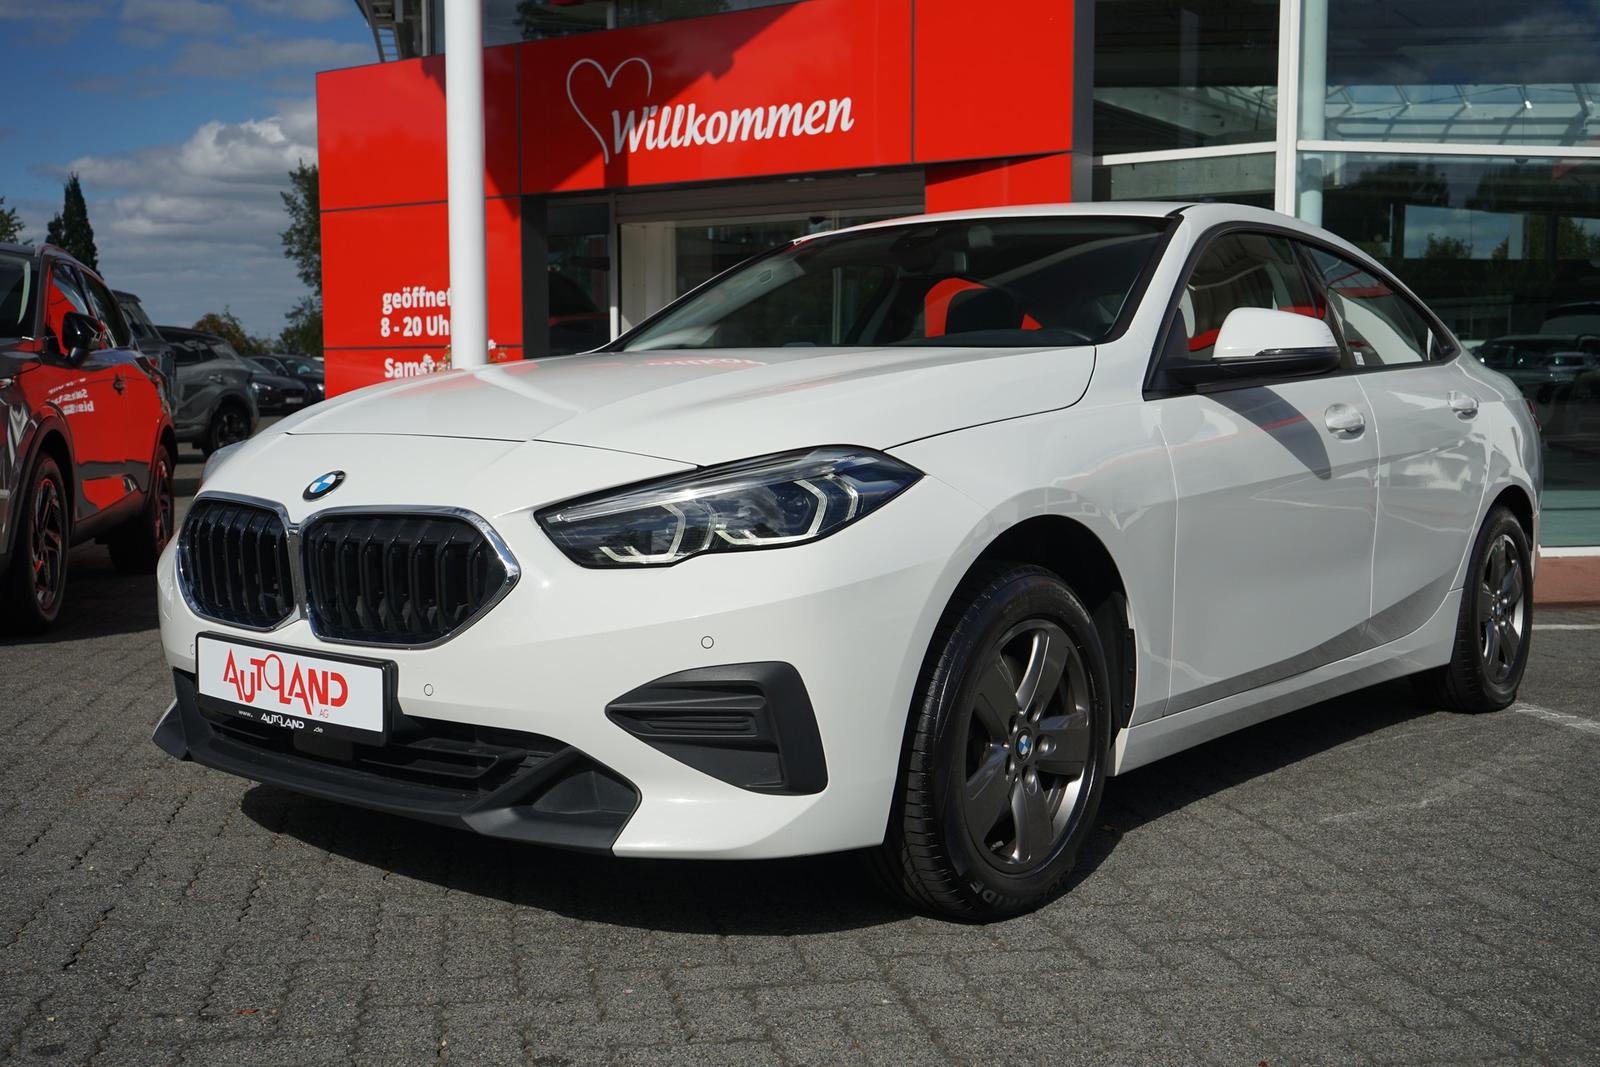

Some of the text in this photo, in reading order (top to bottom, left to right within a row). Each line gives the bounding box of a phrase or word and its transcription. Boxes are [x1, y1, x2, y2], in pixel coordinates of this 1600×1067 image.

[612, 97, 854, 154] Willkommen
[380, 317, 391, 337] 8
[403, 316, 422, 337] 20
[426, 314, 451, 336] Uh
